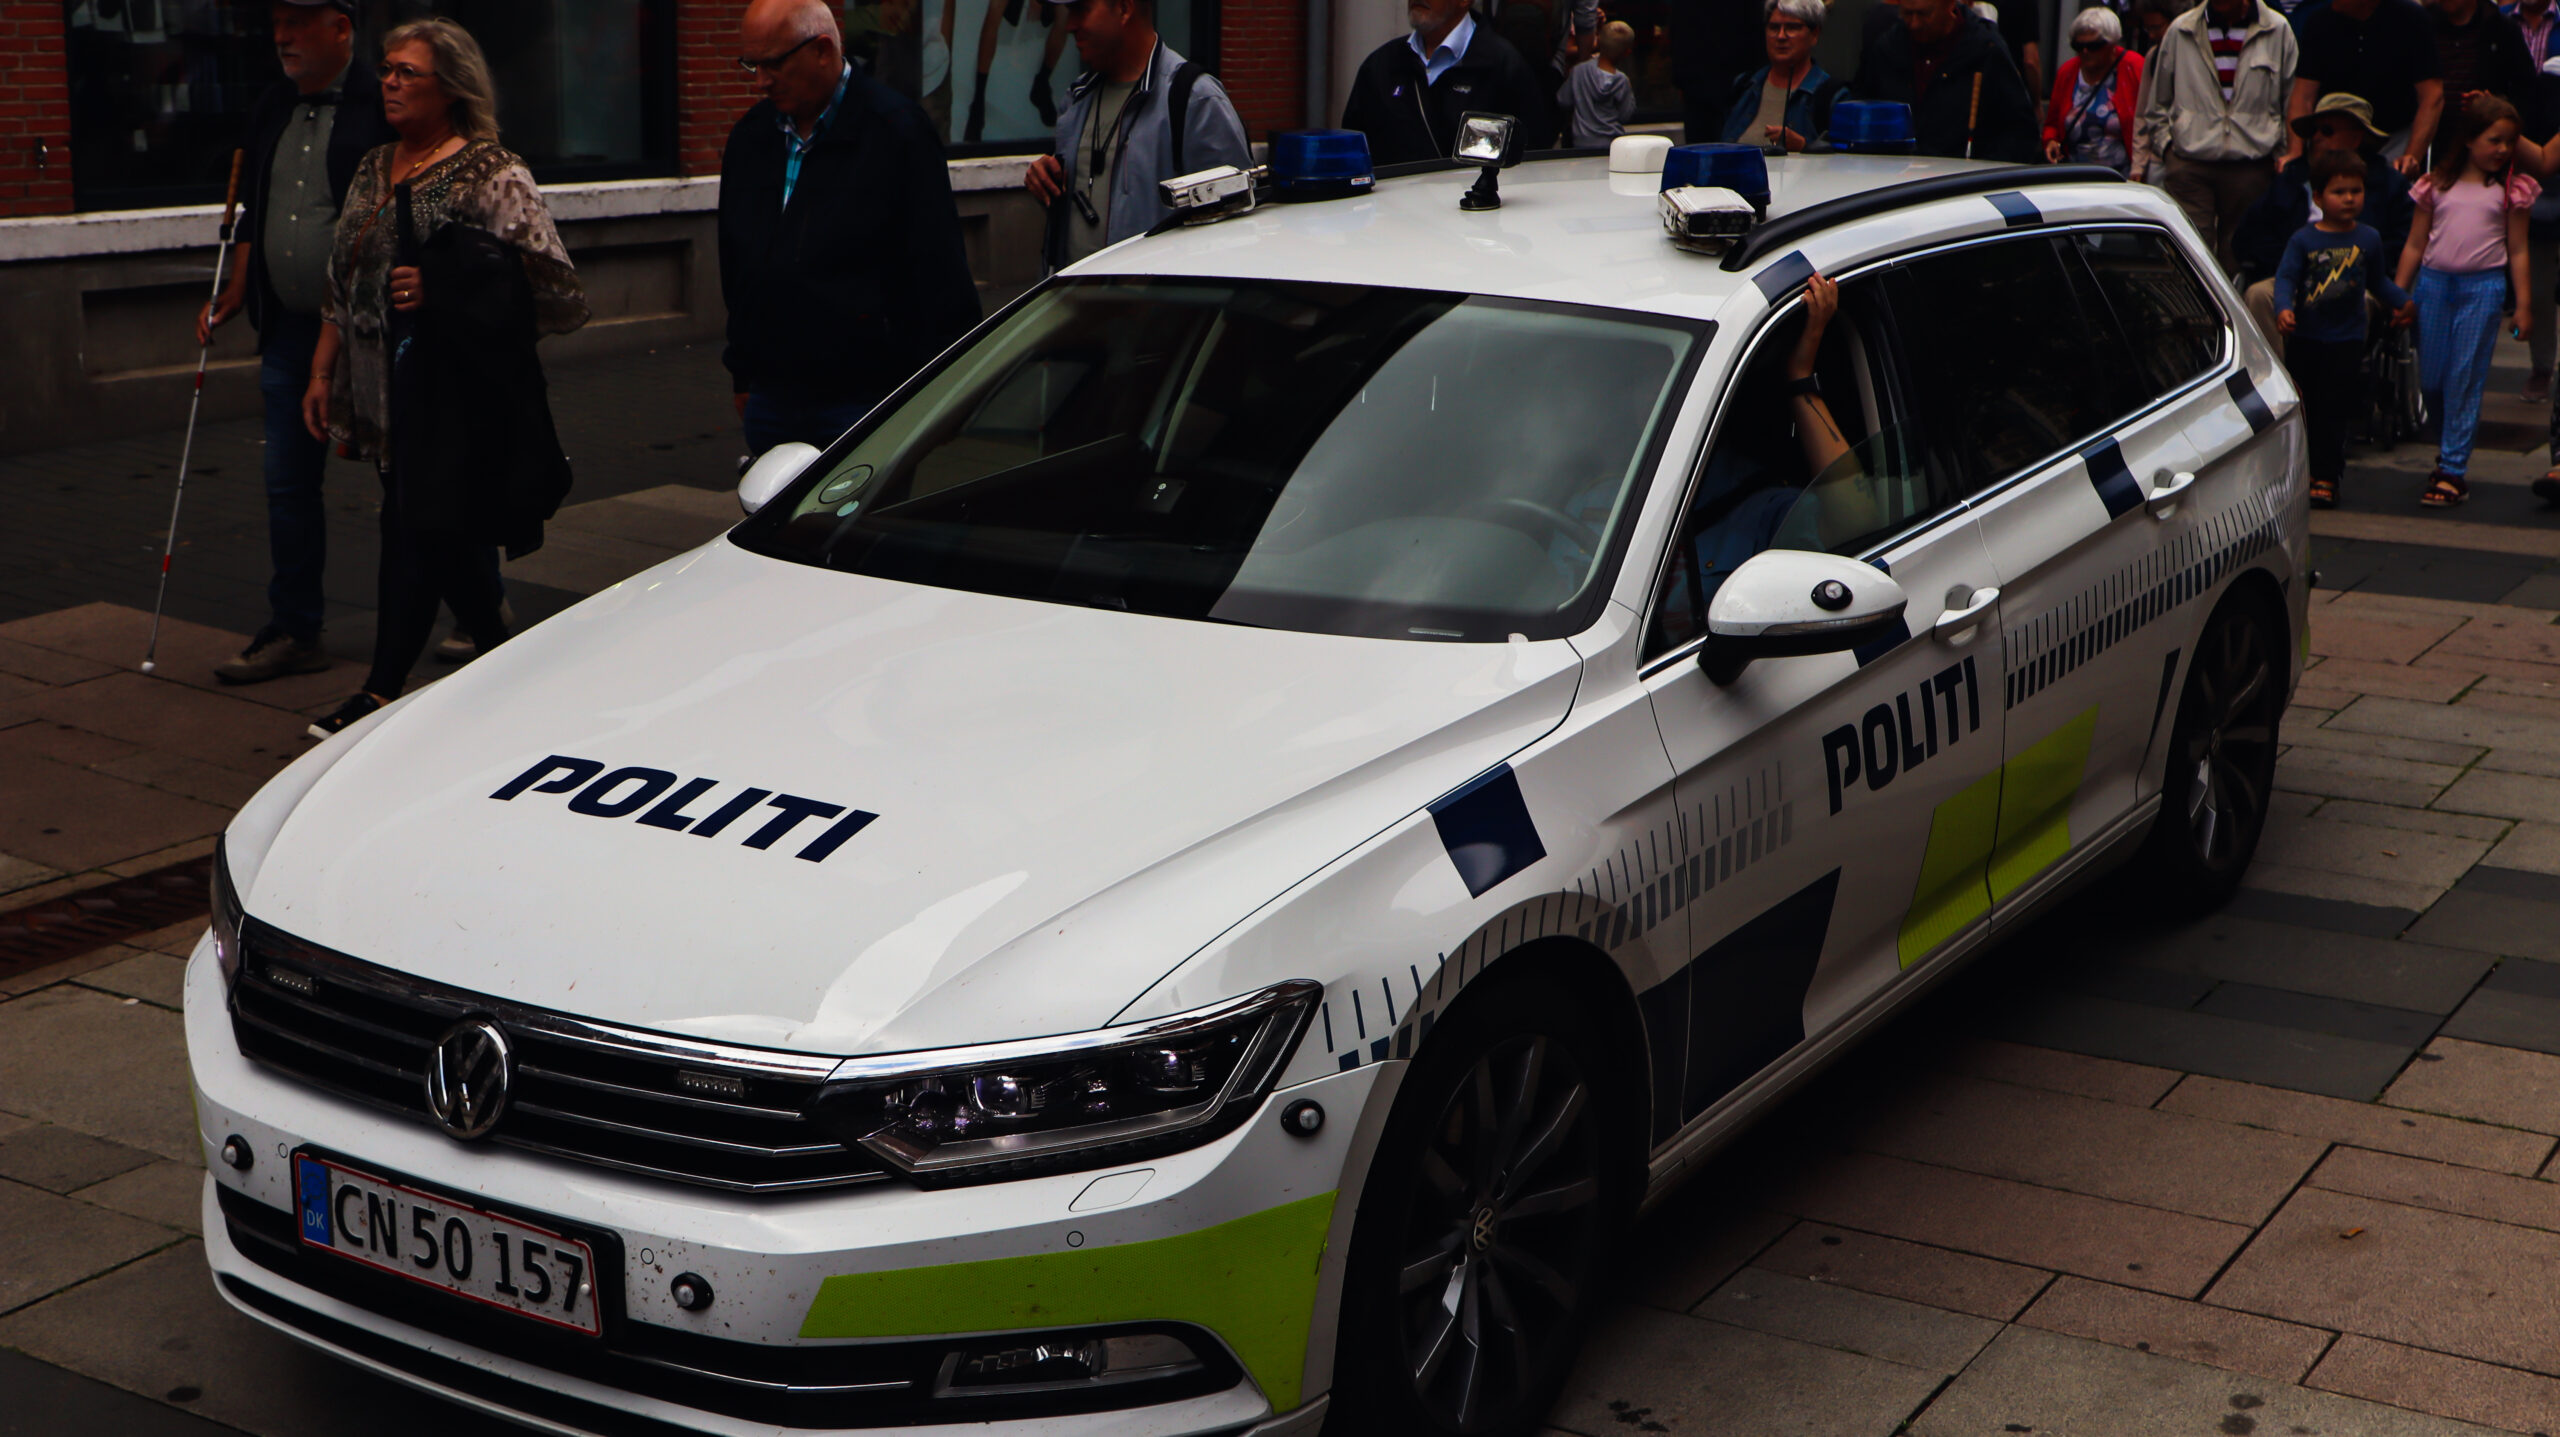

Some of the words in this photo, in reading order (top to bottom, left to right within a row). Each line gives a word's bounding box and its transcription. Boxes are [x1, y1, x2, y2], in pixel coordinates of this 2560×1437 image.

[1822, 655, 1980, 816] POLITI
[489, 754, 880, 863] POLITI
[306, 1208, 325, 1231] DK
[334, 1184, 398, 1258] CN
[413, 1207, 472, 1281] 50
[493, 1232, 582, 1312] 157
